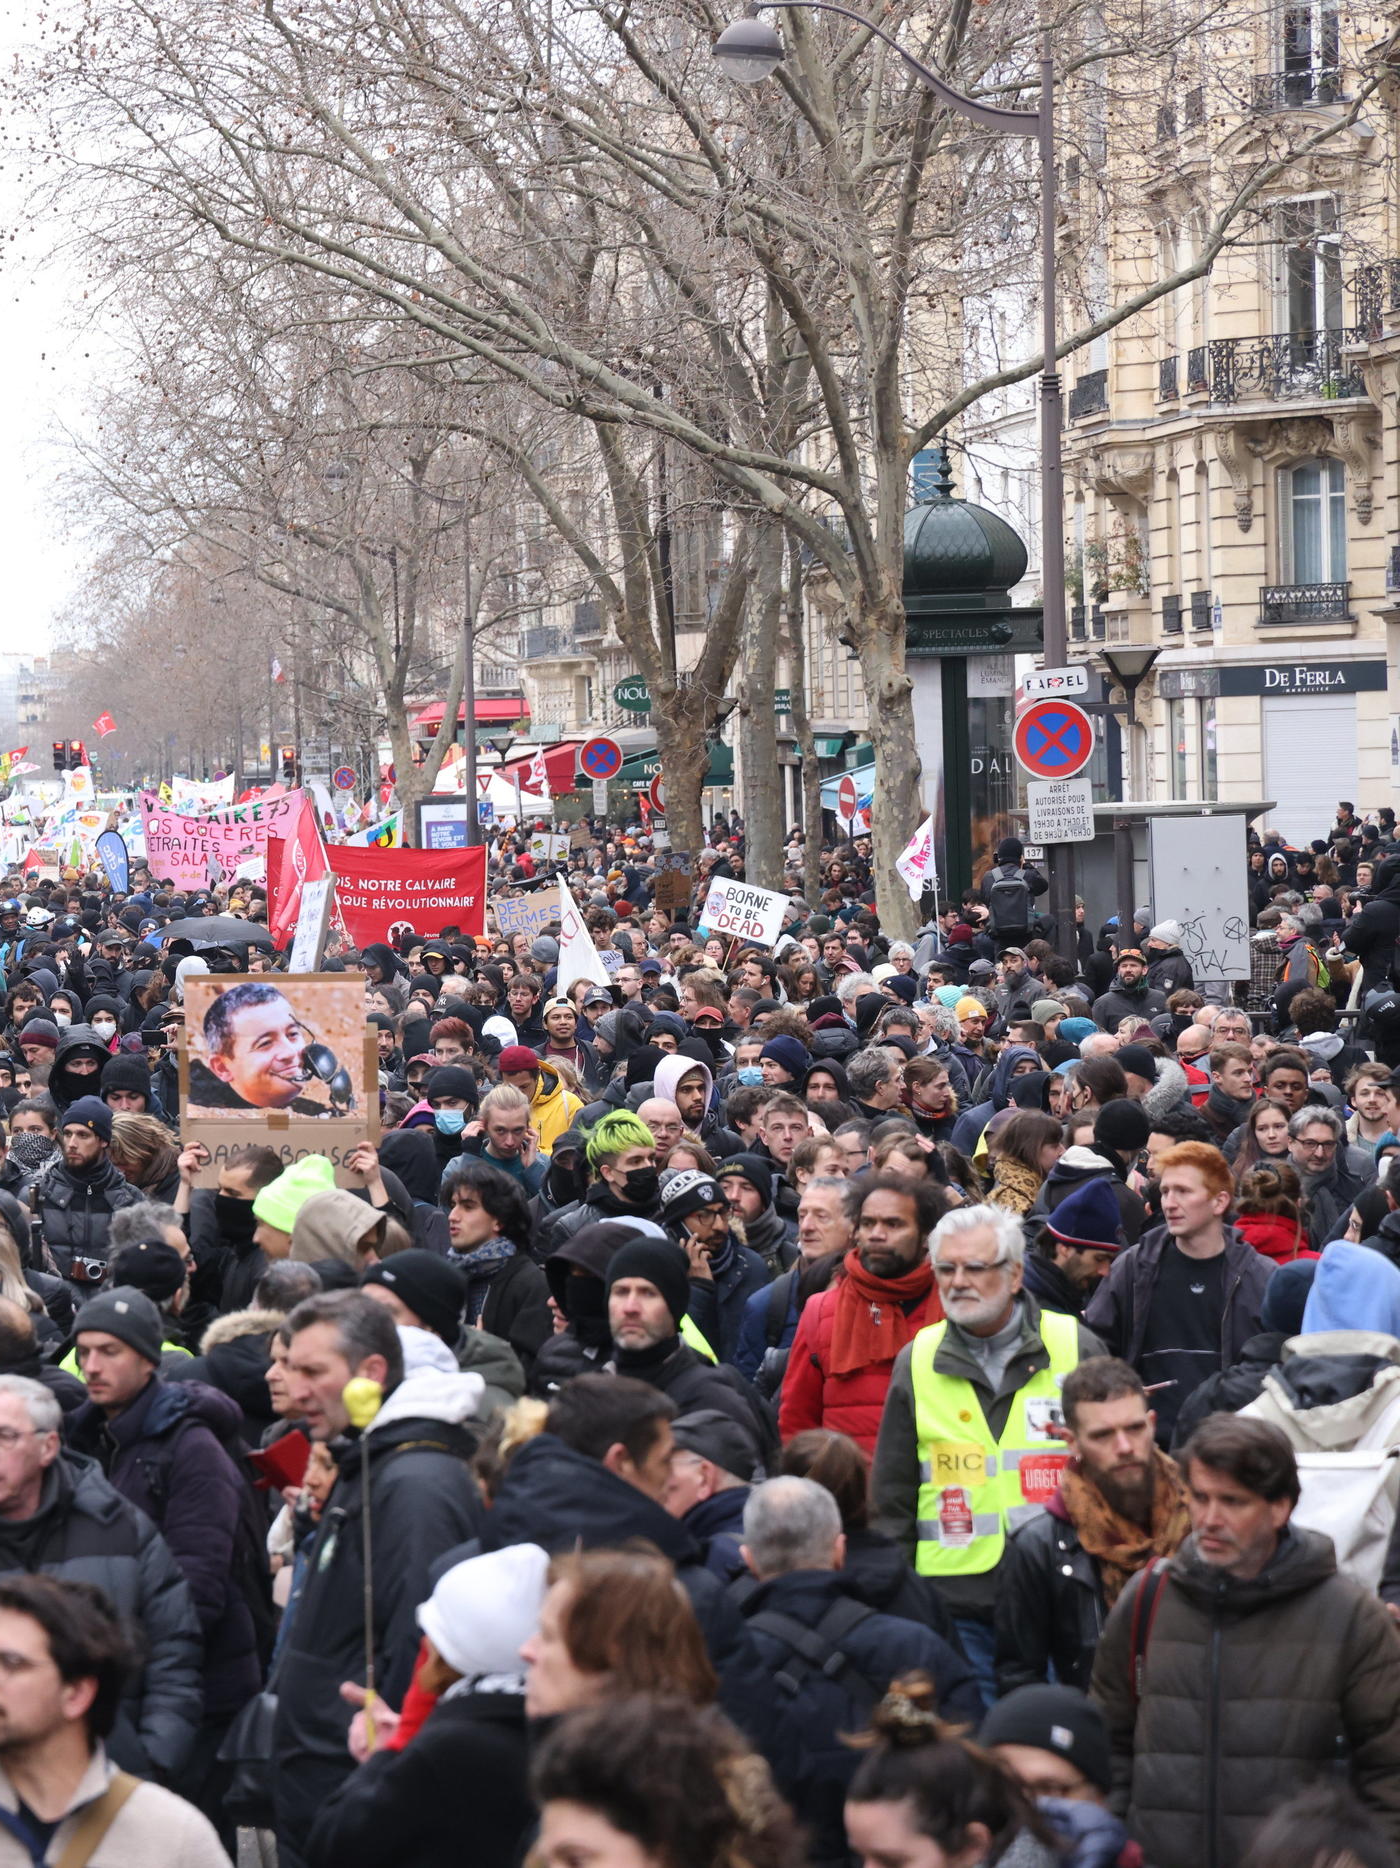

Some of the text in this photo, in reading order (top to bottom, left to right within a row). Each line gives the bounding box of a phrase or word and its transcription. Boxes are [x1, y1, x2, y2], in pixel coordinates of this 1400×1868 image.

[922, 628, 990, 639] SPECTACLES
[618, 687, 649, 700] NOU
[1049, 783, 1070, 793] ARRÊT
[1068, 796, 1086, 804] POUR
[1037, 807, 1085, 817] LIVRAISONS DE
[1034, 820, 1055, 828] 19H30
[1063, 817, 1081, 827] 7H30
[1082, 816, 1090, 825] ET
[1034, 831, 1043, 840] DE
[171, 852, 241, 867] SALARES
[1026, 848, 1041, 857] 137
[358, 878, 401, 891] NOTRE
[405, 877, 457, 891] CALVAIRE
[371, 895, 475, 910] RÉVOLUTIONNAIRE
[725, 886, 773, 912] BORNE
[496, 898, 529, 916] DES
[728, 904, 761, 920] TO BE
[500, 904, 562, 928] PLUMES
[717, 913, 765, 938] DEAD
[936, 1452, 983, 1471] RIC
